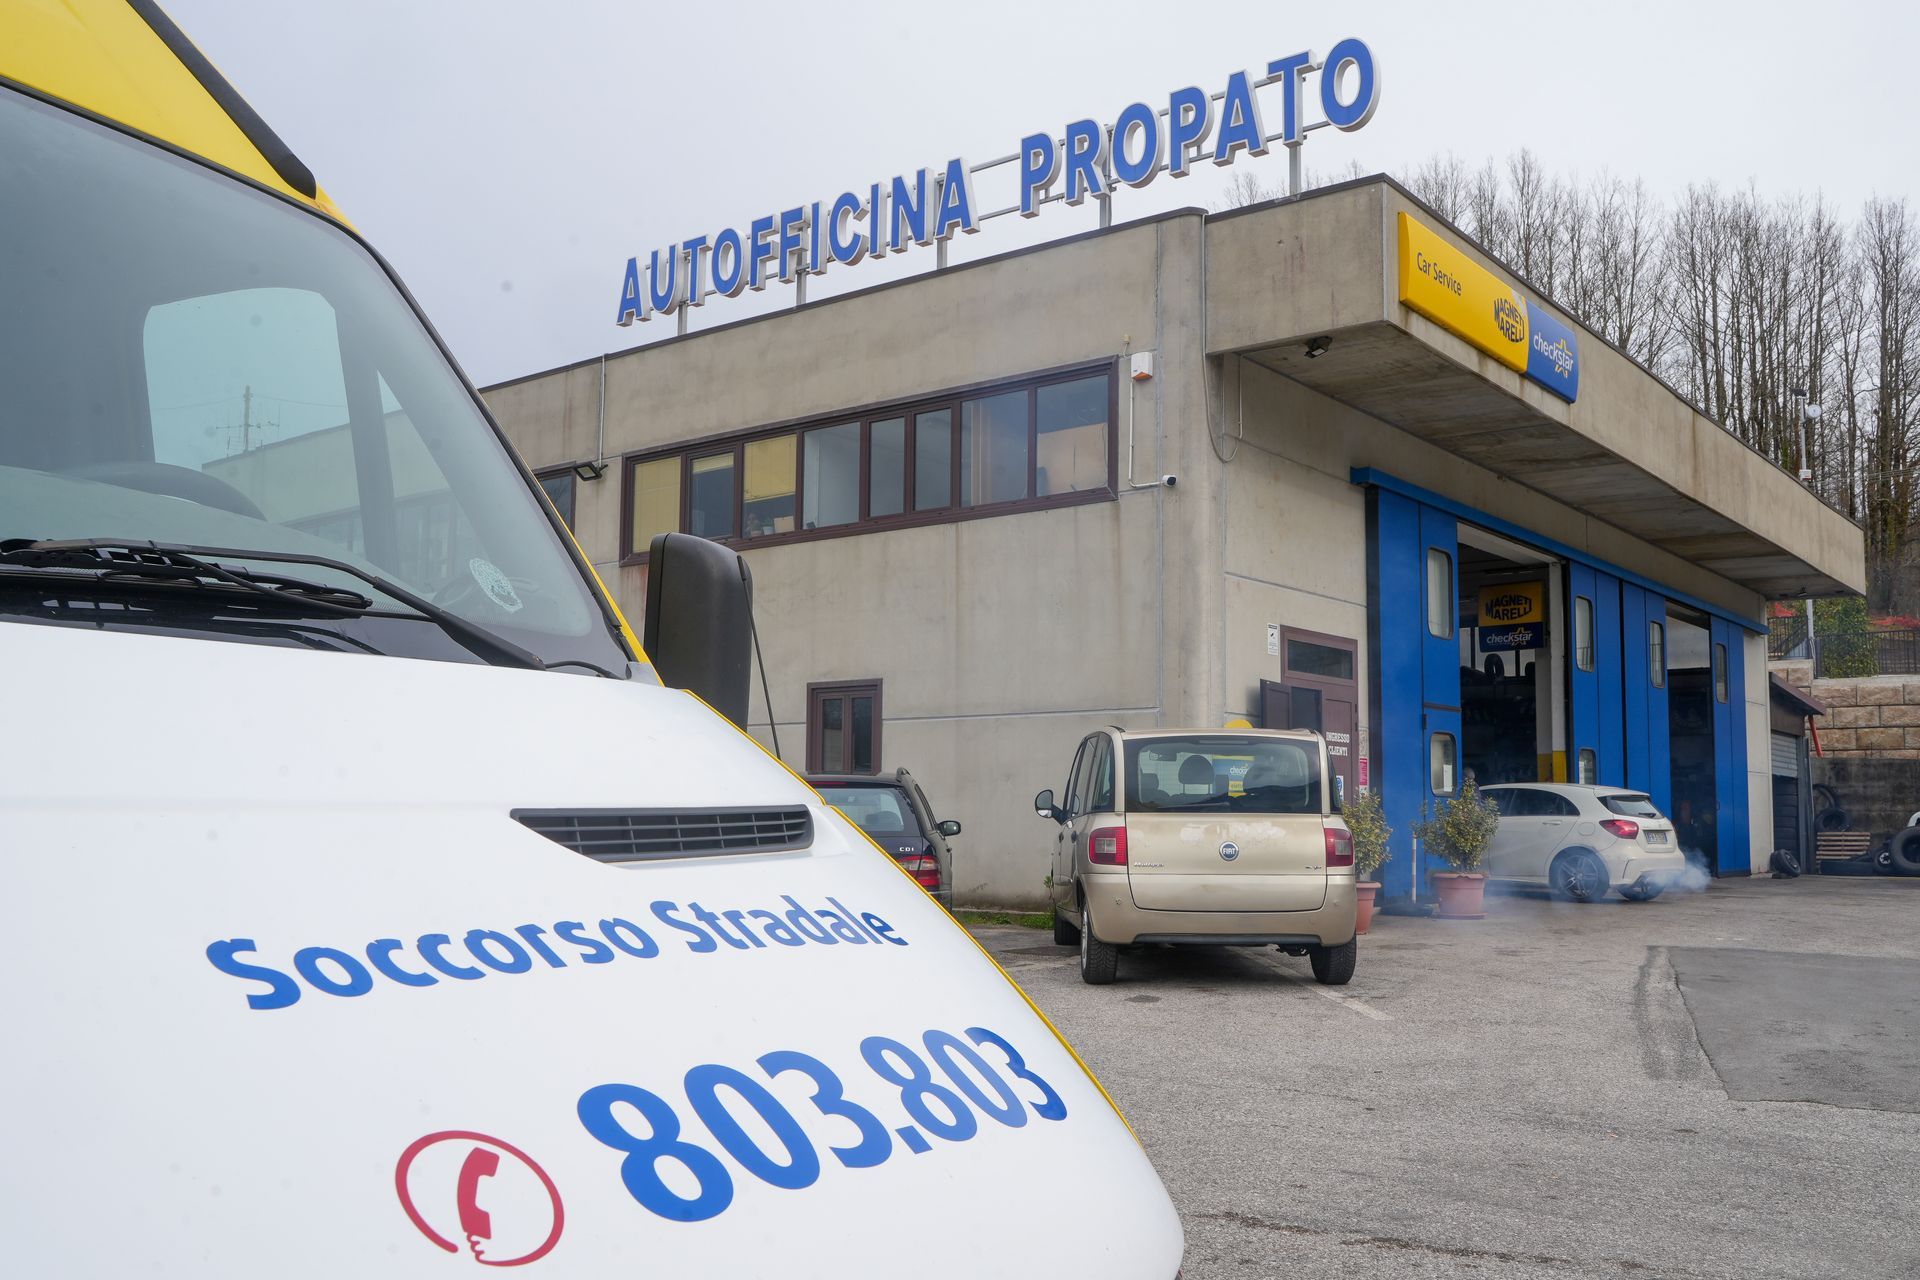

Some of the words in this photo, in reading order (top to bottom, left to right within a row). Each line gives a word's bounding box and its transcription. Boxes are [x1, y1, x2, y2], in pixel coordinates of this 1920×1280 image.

[616, 157, 980, 327] AUTOFFICINA
[1019, 36, 1382, 219] PROPATO
[1417, 252, 1431, 276] Car
[1433, 263, 1462, 296] Service
[1533, 332, 1574, 371] checkstar
[1486, 632, 1533, 644] checkstar
[205, 917, 661, 1011] Soccorso
[649, 894, 909, 954] Stradale
[577, 1026, 1068, 1223] 803.803
